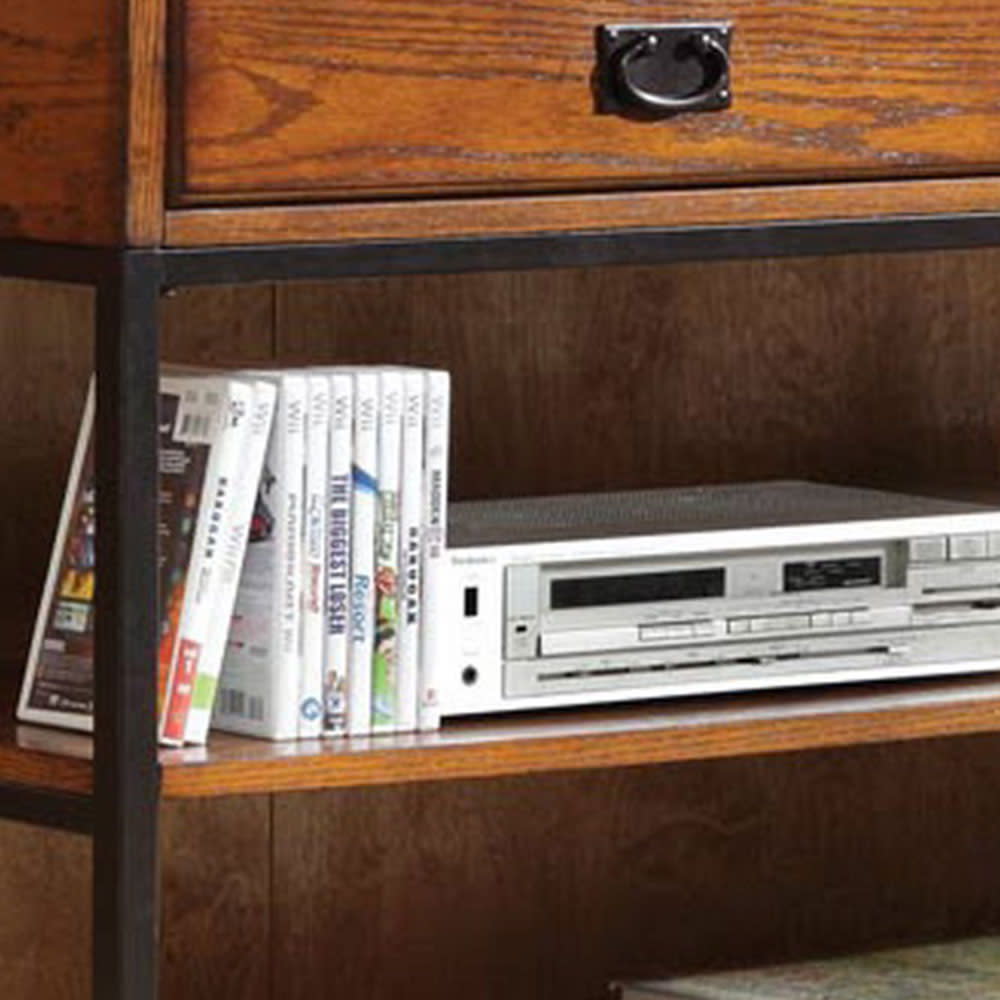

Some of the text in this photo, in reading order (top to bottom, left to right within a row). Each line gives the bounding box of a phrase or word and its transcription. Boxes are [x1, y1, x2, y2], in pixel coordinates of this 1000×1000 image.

[328, 474, 347, 635] THE BIGGEST LOSER
[353, 574, 369, 643] Resort
